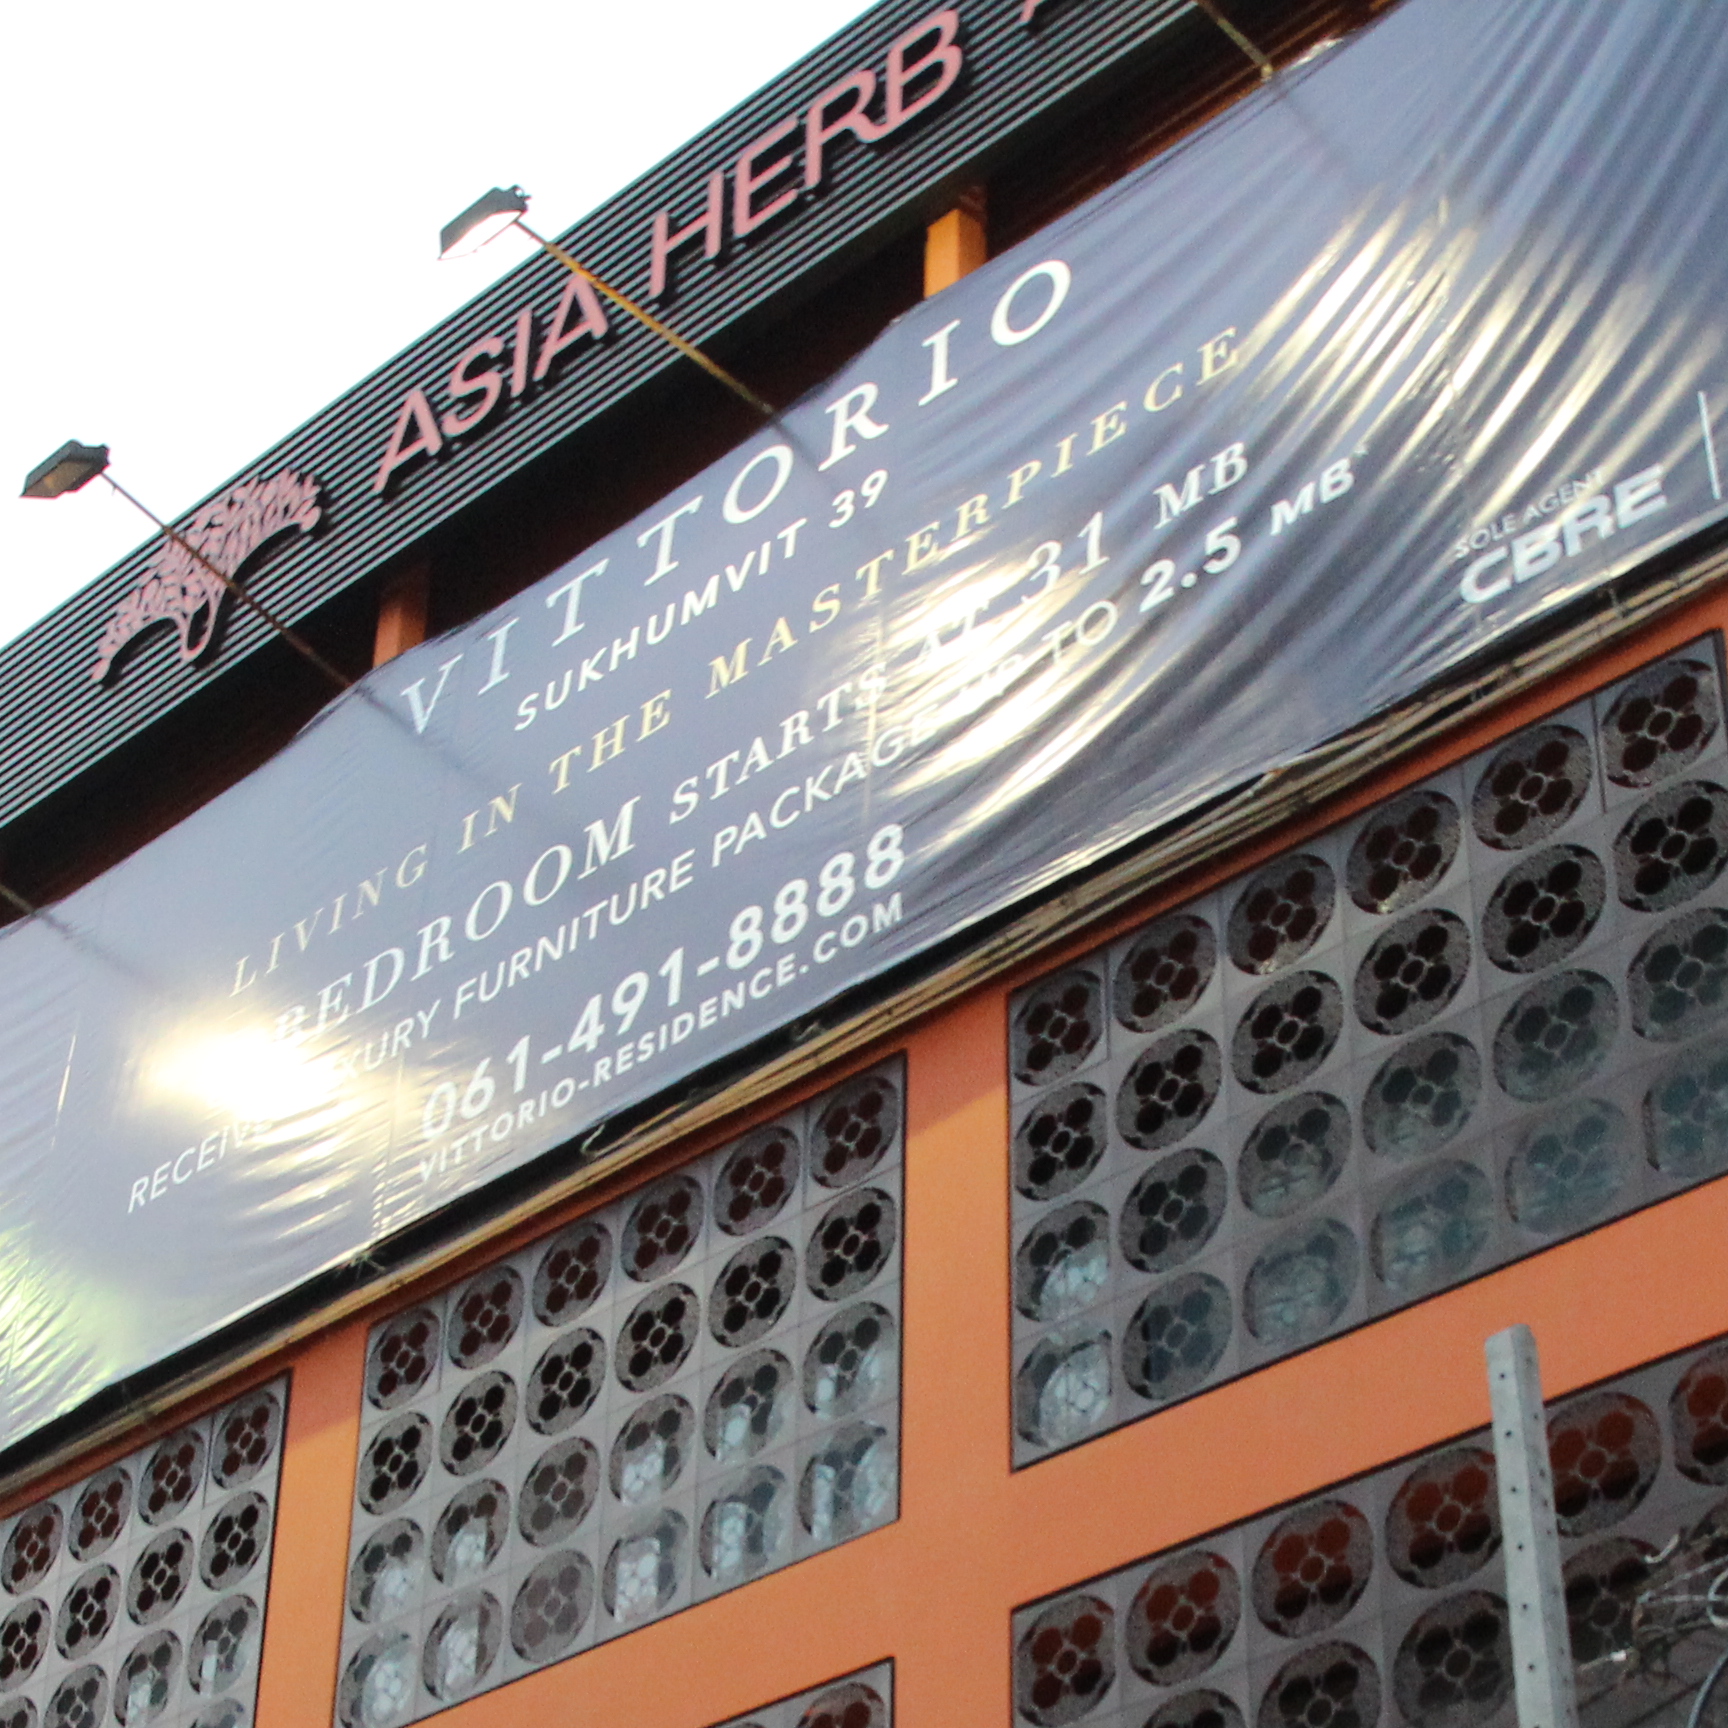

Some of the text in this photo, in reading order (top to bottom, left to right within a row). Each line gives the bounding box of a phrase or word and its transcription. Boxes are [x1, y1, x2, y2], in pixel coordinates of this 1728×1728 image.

[372, 8, 962, 491] ASIA HERB
[229, 327, 1240, 997] LIVING IN THE MASTERPIECE
[400, 258, 1071, 734] VITTORIO
[514, 469, 889, 732] SUKHUMVIT 39
[1454, 466, 1608, 558] SOLE AGENT
[1459, 463, 1669, 603] CBRE
[271, 442, 1249, 1043] BEDROOM STARTS AT 31 MB
[453, 850, 697, 1019] FURNITURE
[710, 702, 939, 868] PACKAGE
[1041, 600, 1118, 664] TO
[1139, 517, 1241, 613] 2.5
[418, 892, 904, 1183] VITTORIO-RESIDENCE.COM
[420, 822, 906, 1142] 061-491-8888
